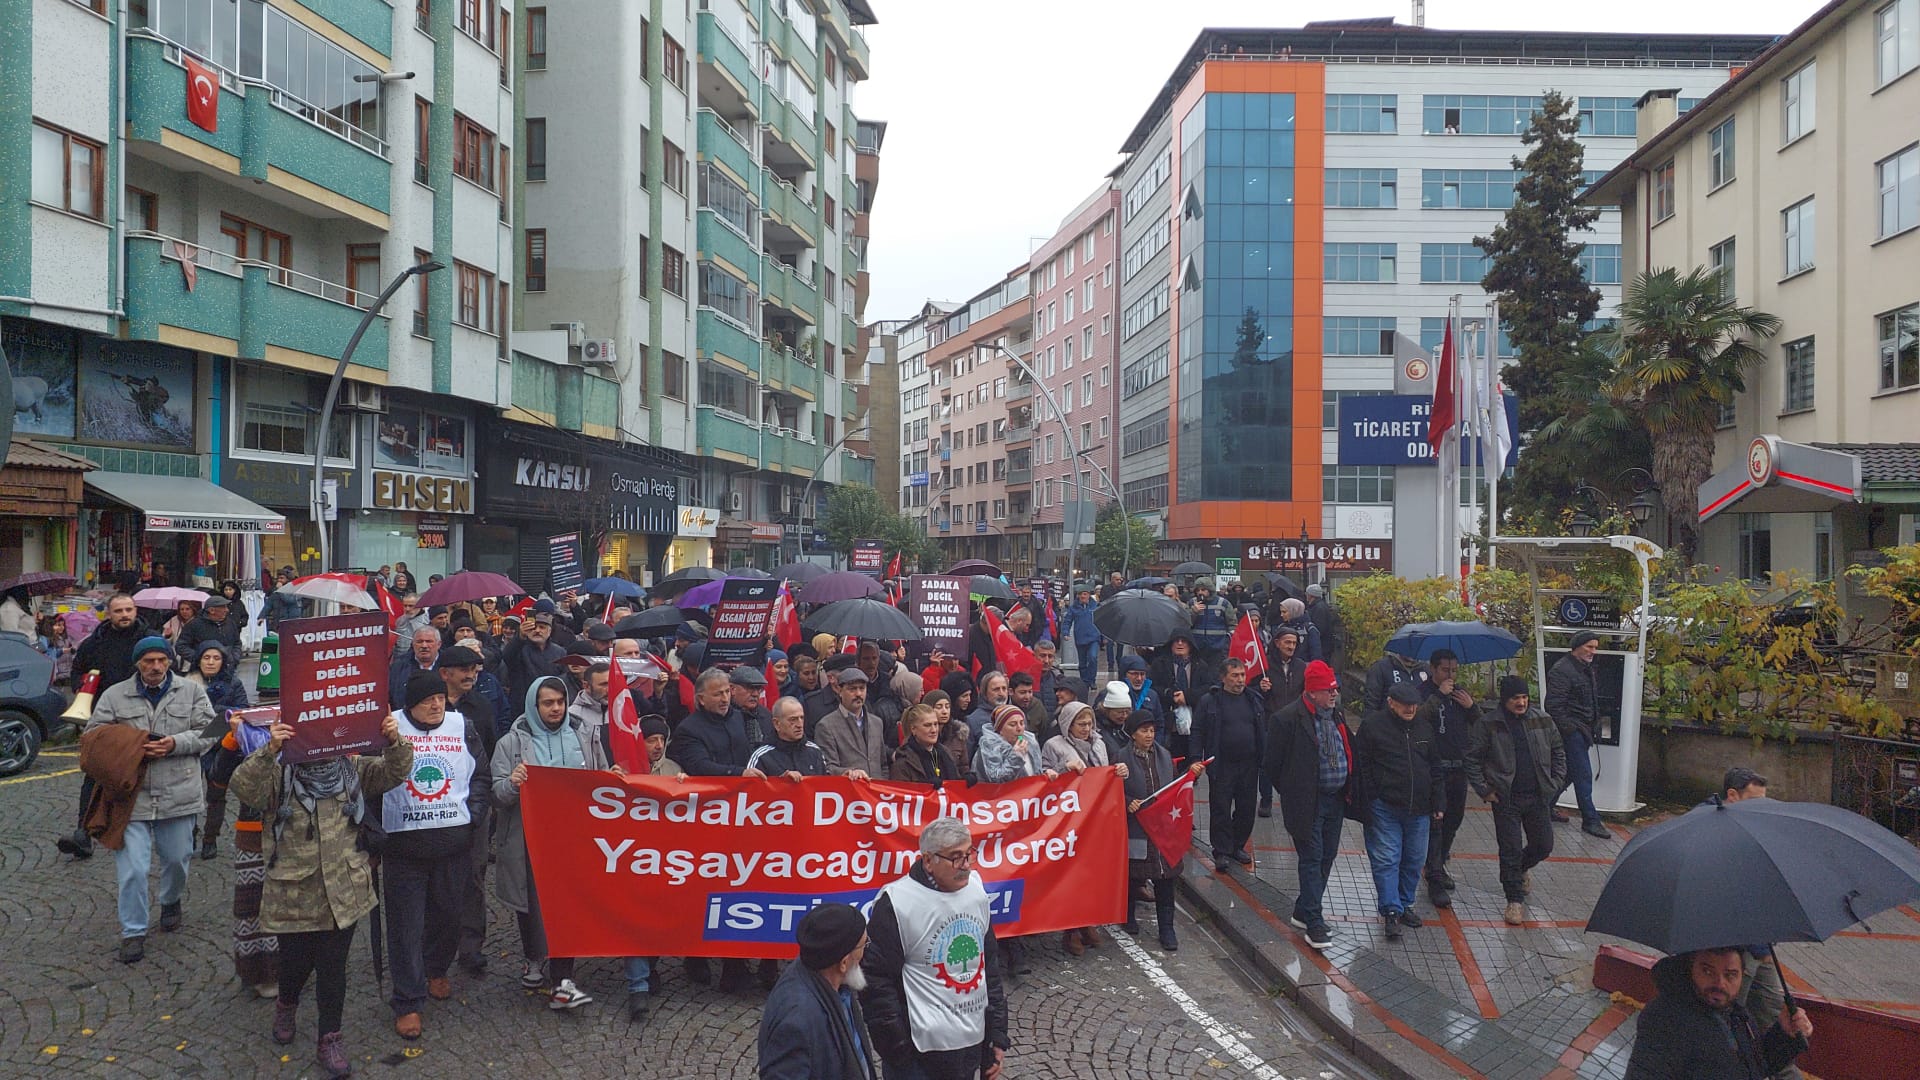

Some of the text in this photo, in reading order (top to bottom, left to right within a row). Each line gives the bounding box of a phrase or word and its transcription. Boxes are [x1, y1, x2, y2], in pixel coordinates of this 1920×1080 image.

[1353, 418, 1422, 438] TİCARET
[515, 457, 591, 492] KARSU
[373, 471, 470, 512] EHSEN
[611, 472, 676, 500] Osmanlı Perde
[173, 519, 210, 529] MATEKS
[212, 521, 224, 530] EV
[227, 520, 262, 531] TEKSTİL
[922, 580, 959, 590] SADAKA
[928, 591, 953, 601] DEĞİL
[919, 603, 960, 613] İNSANCA
[719, 611, 767, 623] ASGARİ ÜCRET
[923, 615, 957, 626] YAŞAM
[294, 625, 385, 645] YOKSULLUK
[715, 623, 764, 639] OLMALI 39!
[922, 627, 964, 638] TİYORUZ
[313, 646, 366, 662] KADER
[316, 663, 361, 680] DEĞİL
[302, 682, 377, 702] BU ÜCRET
[297, 699, 379, 723] ADİL DEĞİL
[433, 744, 462, 754] YAŞAM
[402, 810, 458, 822] PAZAR-Rize
[588, 786, 1082, 834] Sadaka Değil İnsanca
[593, 829, 1079, 886] Yaşayacağım Ücret
